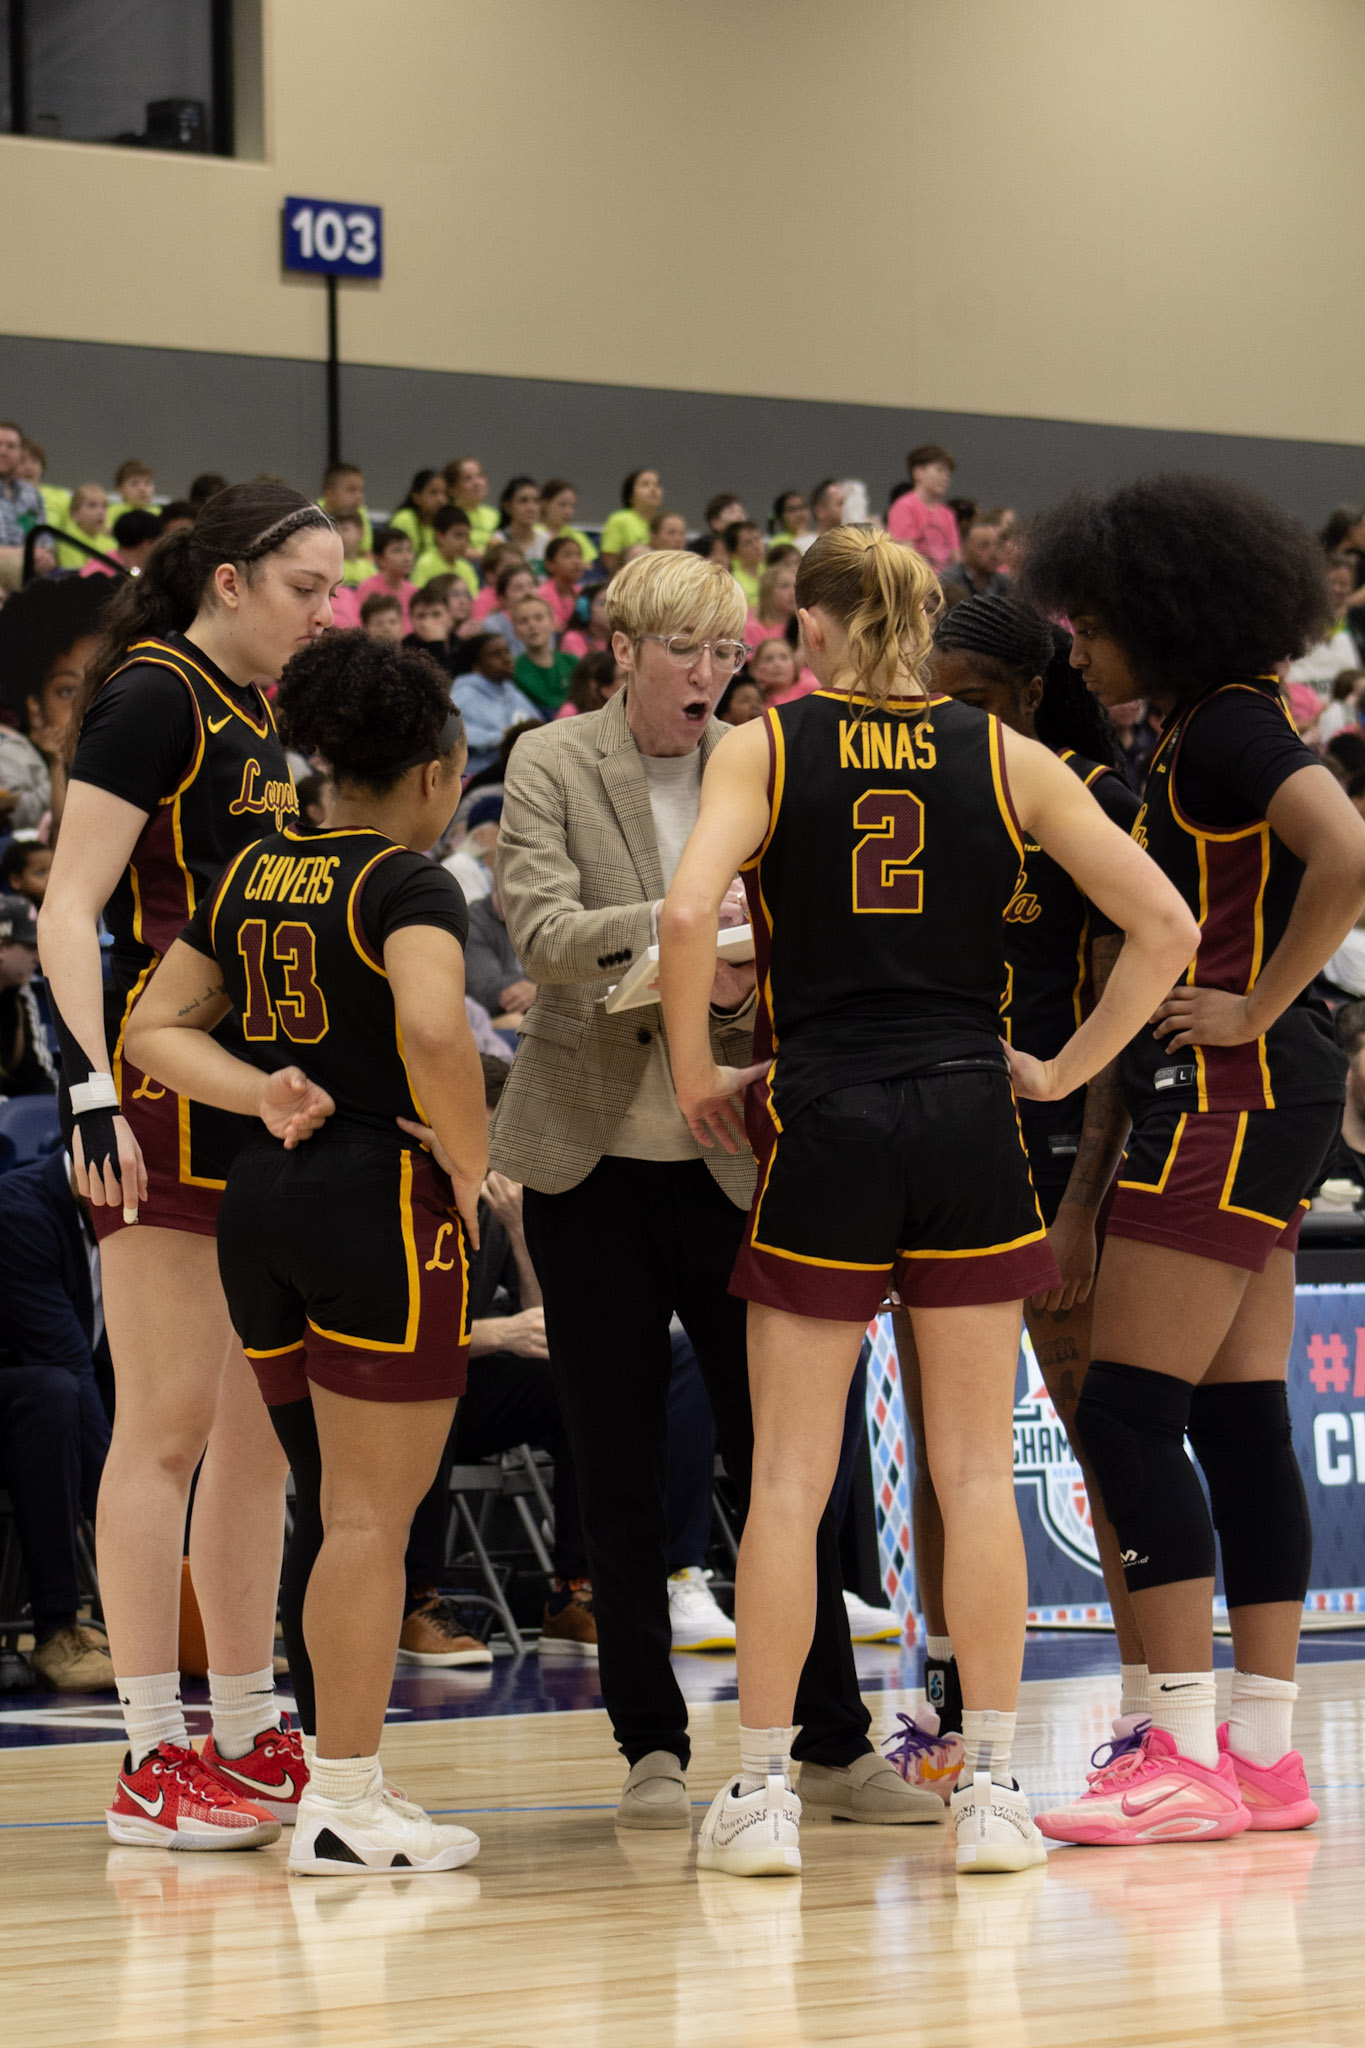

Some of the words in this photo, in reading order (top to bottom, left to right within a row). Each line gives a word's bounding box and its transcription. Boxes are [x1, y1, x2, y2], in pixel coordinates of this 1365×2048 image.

[291, 206, 377, 265] 103
[838, 720, 938, 770] KINAS
[244, 853, 341, 904] CHIVERS
[852, 789, 925, 913] 2
[237, 919, 330, 1044] 13
[425, 1222, 454, 1271] L
